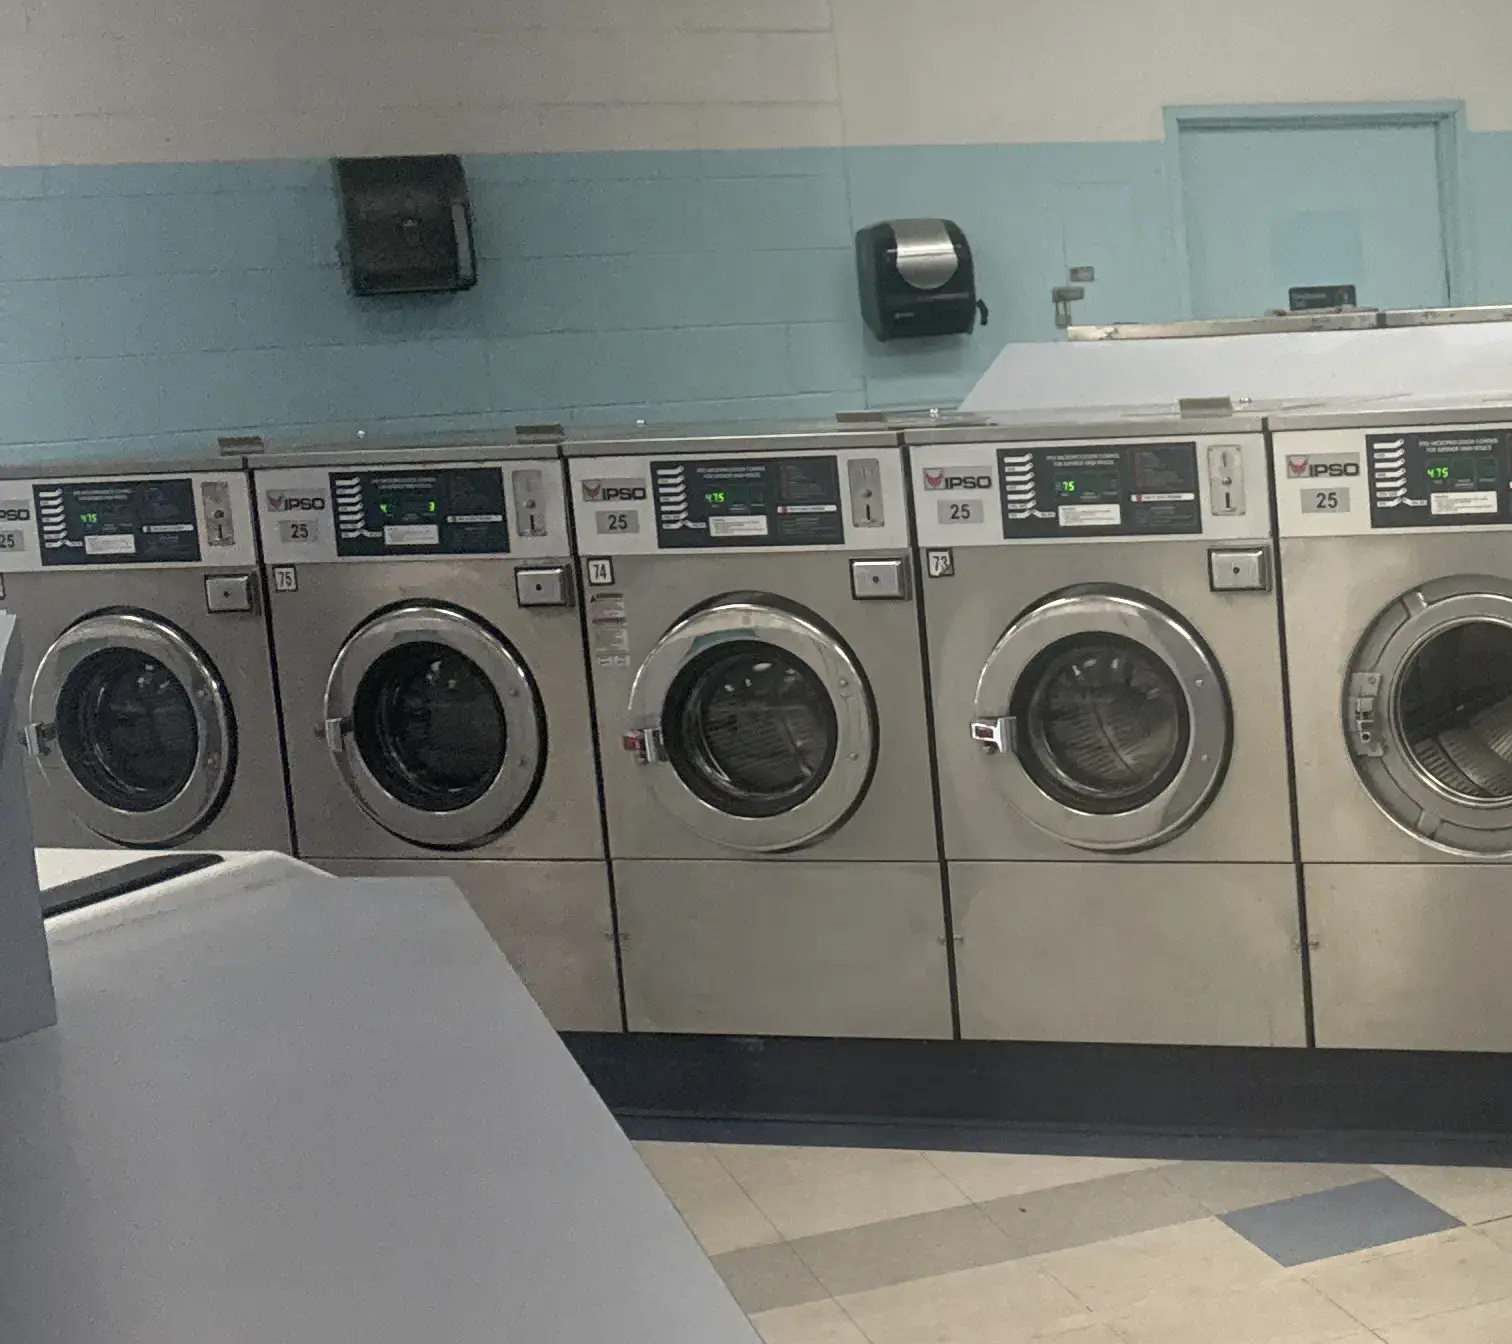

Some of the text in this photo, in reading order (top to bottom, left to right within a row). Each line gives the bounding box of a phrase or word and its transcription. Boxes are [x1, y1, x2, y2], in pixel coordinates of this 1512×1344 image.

[1309, 462, 1360, 477] IPSO
[944, 476, 992, 490] IPSO
[602, 487, 646, 501] IPSO
[1316, 491, 1338, 509] 25
[284, 497, 325, 511] IPSO
[950, 504, 971, 519] 25
[0, 509, 30, 521] PSO
[608, 514, 627, 530] 25
[290, 524, 309, 539] 25
[0, 534, 15, 548] 25
[593, 563, 607, 580] 74
[278, 571, 293, 588] 75
